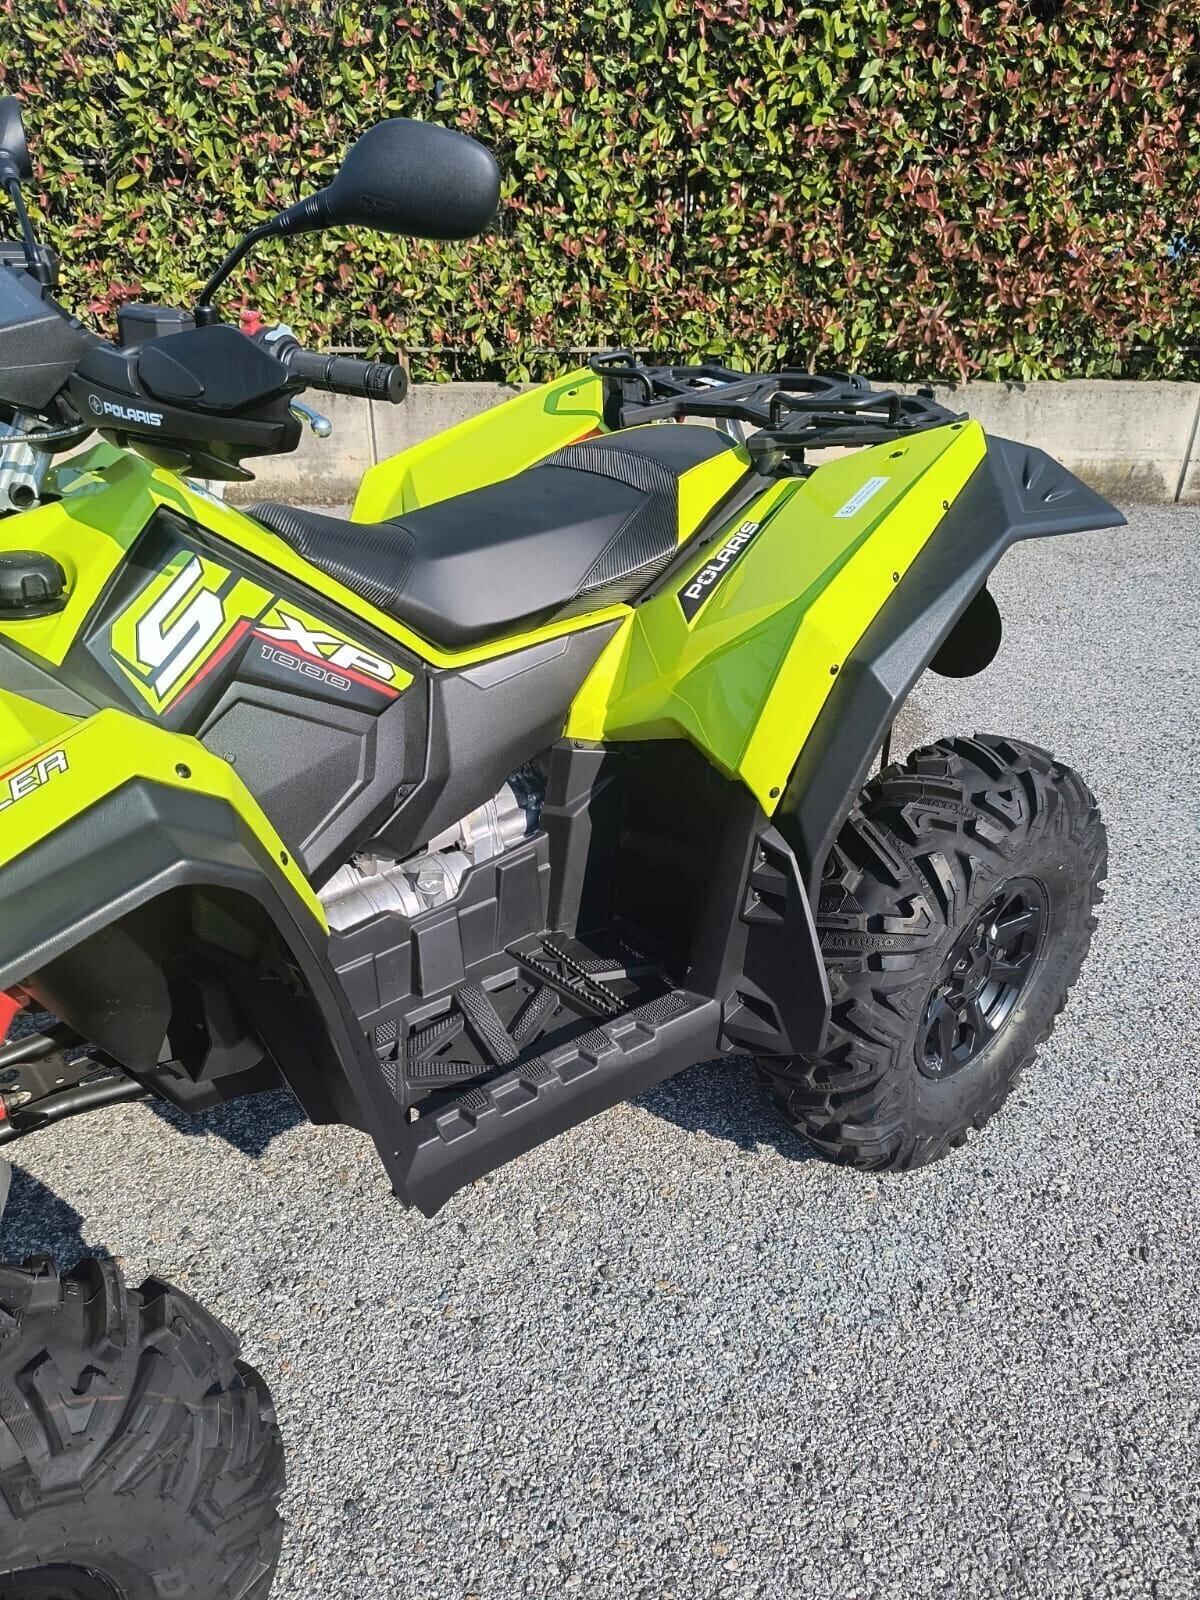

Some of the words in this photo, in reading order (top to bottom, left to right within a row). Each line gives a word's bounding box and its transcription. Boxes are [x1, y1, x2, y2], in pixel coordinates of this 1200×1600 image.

[103, 401, 163, 427] POLARIS
[684, 520, 760, 600] POLARIS
[254, 607, 396, 682] XP
[261, 645, 351, 691] 1000
